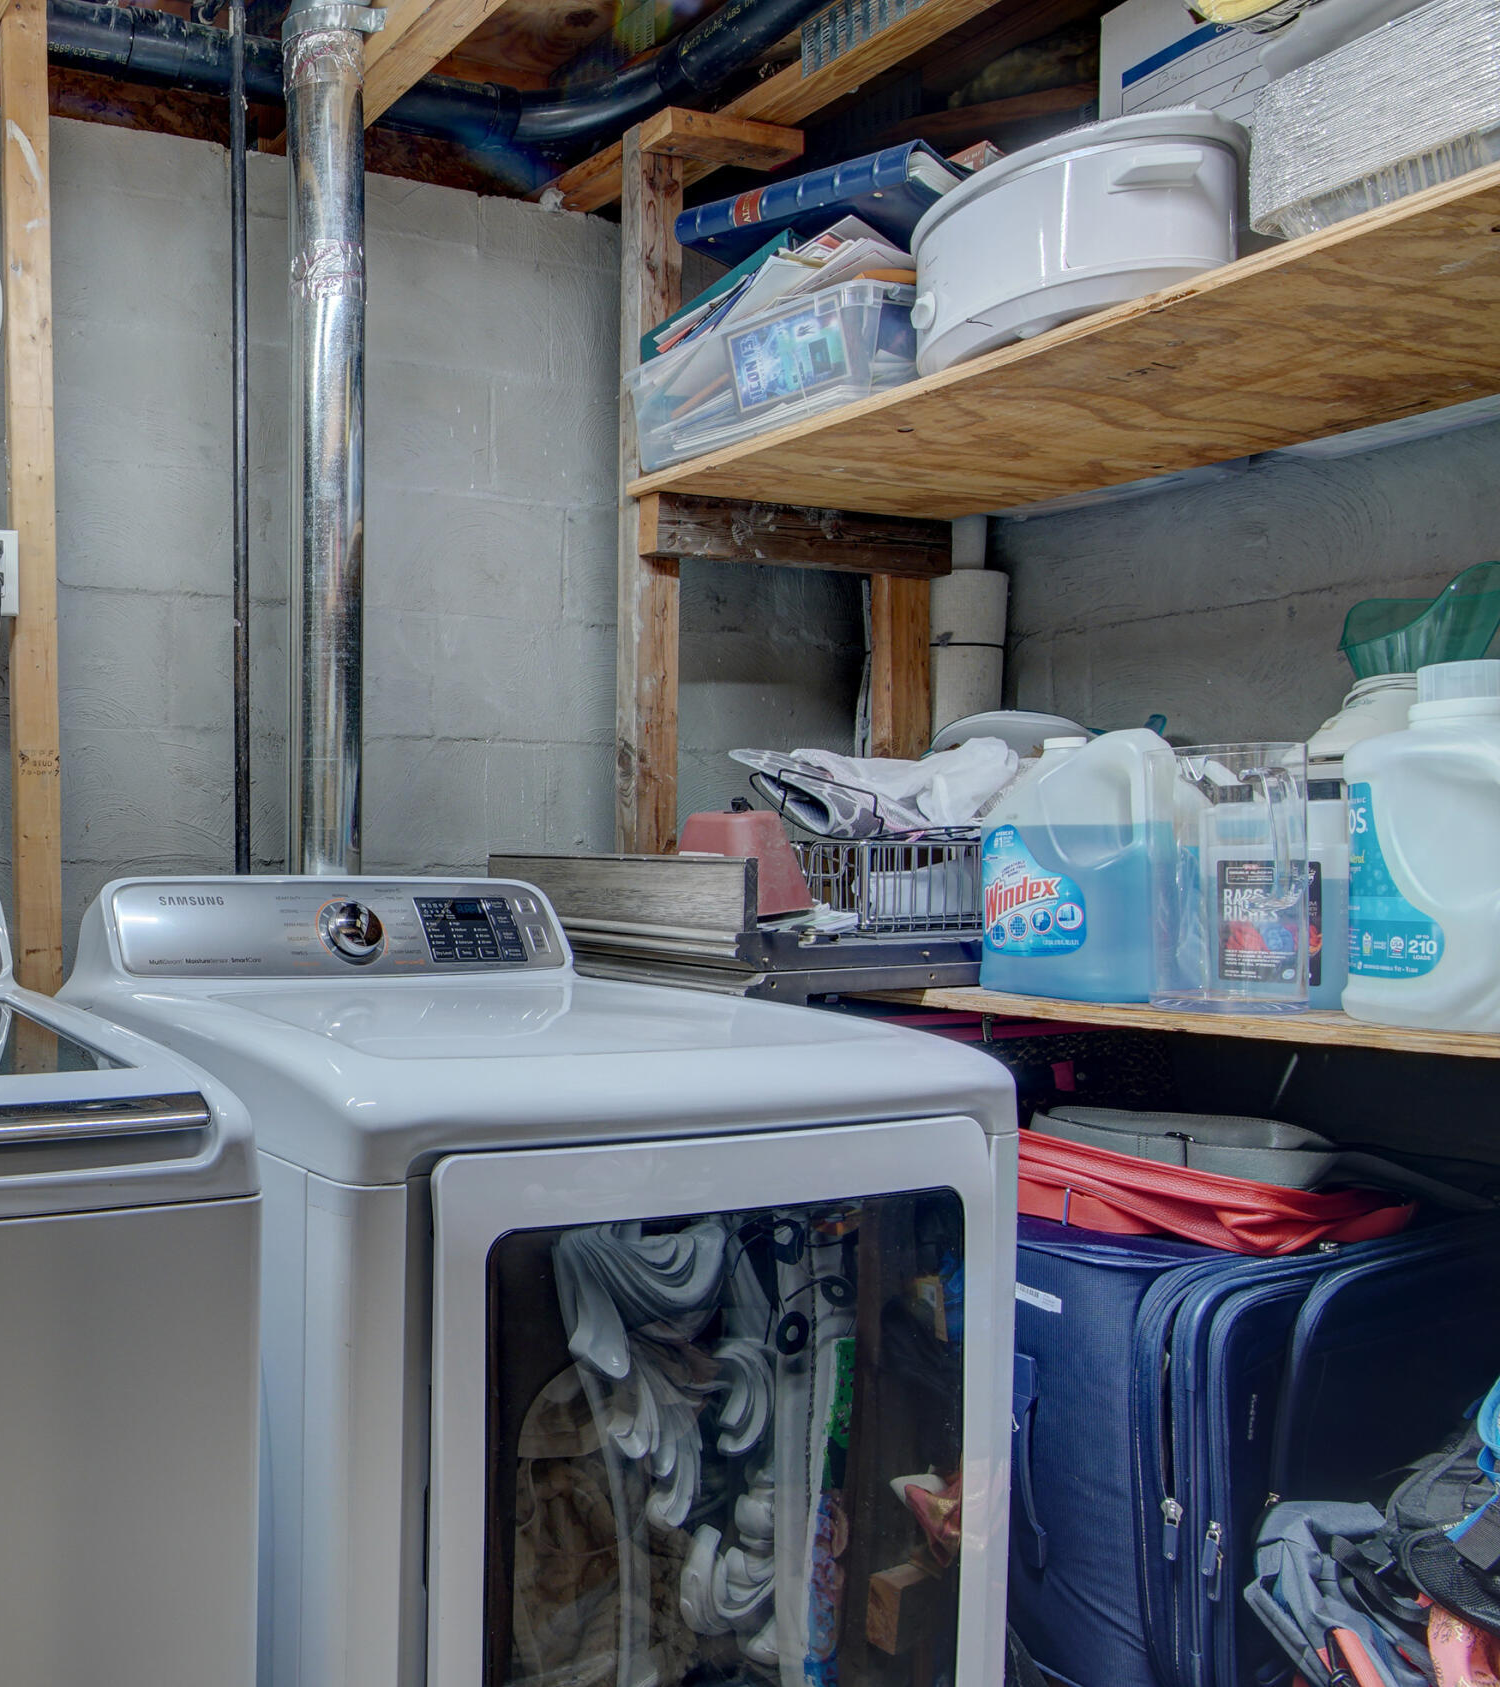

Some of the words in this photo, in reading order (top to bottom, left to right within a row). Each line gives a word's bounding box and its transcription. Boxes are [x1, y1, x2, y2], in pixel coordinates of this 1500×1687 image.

[1348, 807, 1367, 834] OS
[158, 896, 225, 906] SAMSUNG
[985, 876, 1060, 933] Windex
[1408, 940, 1437, 955] 210
